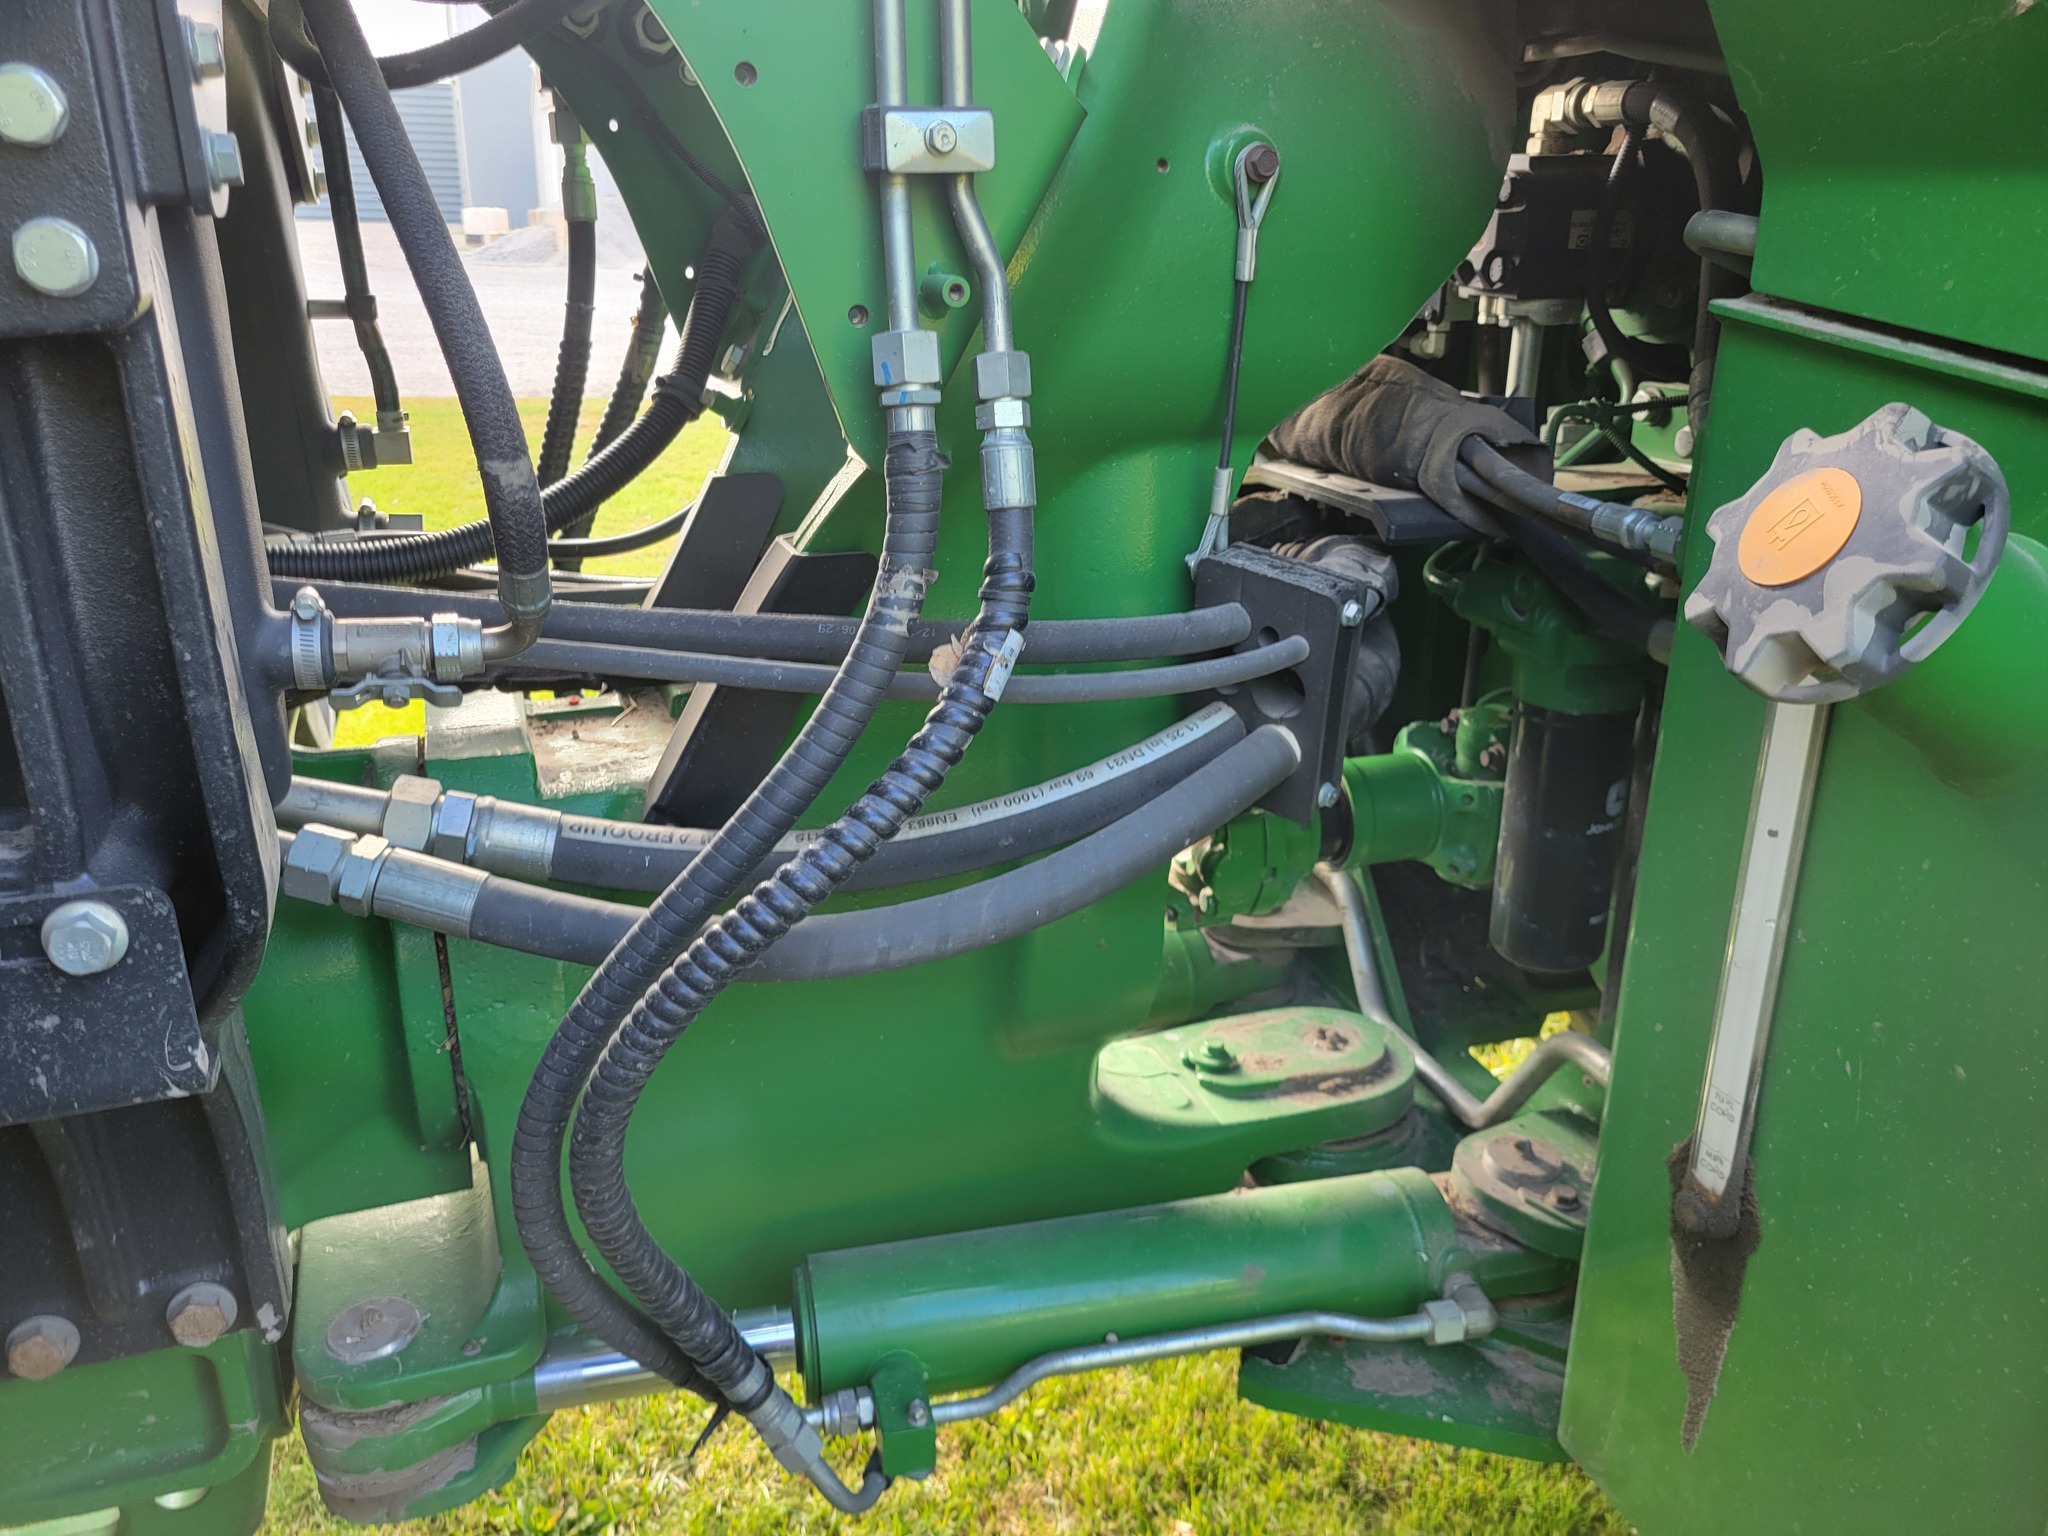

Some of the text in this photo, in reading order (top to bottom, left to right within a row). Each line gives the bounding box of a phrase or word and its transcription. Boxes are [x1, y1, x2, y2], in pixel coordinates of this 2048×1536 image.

[1105, 750, 1145, 771] DN31
[1076, 770, 1094, 783] 69
[1048, 779, 1074, 792] bar
[1003, 788, 1045, 808] (1000
[971, 801, 999, 817] psi)
[907, 812, 958, 830] EN853
